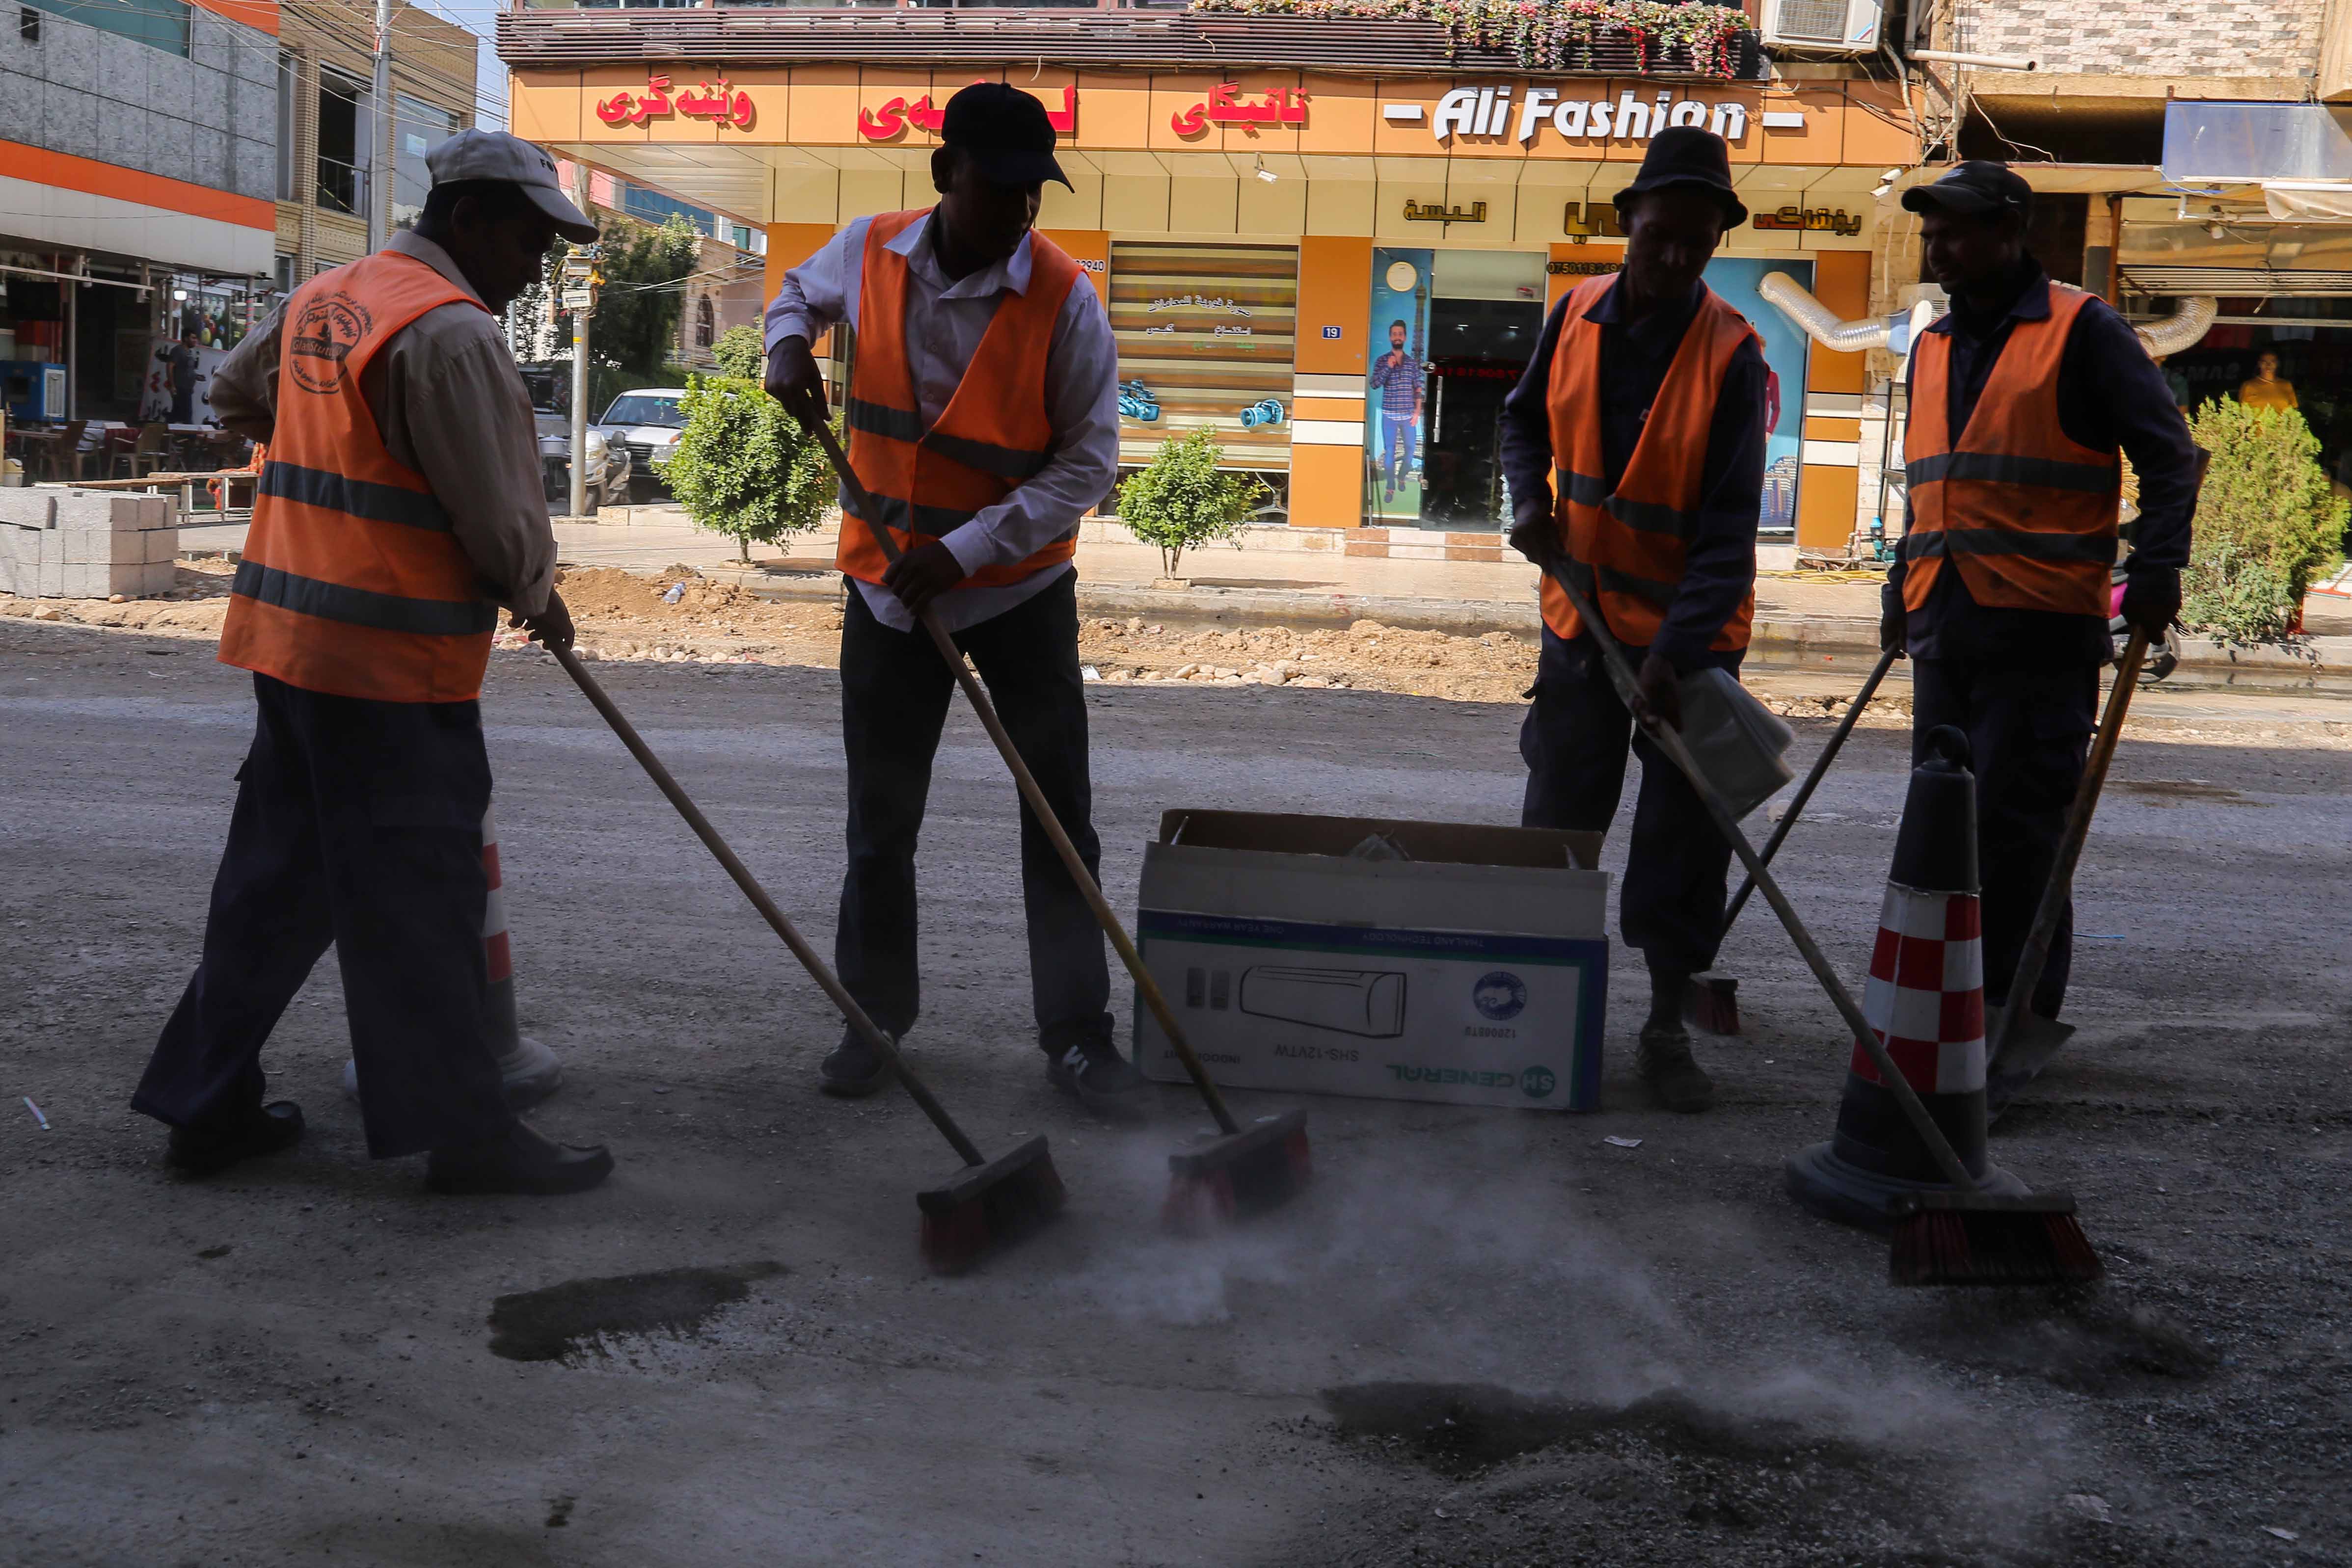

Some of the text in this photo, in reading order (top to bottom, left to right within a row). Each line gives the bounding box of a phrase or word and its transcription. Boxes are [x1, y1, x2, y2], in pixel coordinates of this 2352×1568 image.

[1433, 85, 1746, 143] Ali Fashion
[1326, 327, 1337, 338] 19
[1273, 1044, 1360, 1062] SHS-12VTW
[1386, 1064, 1516, 1088] GENERAL
